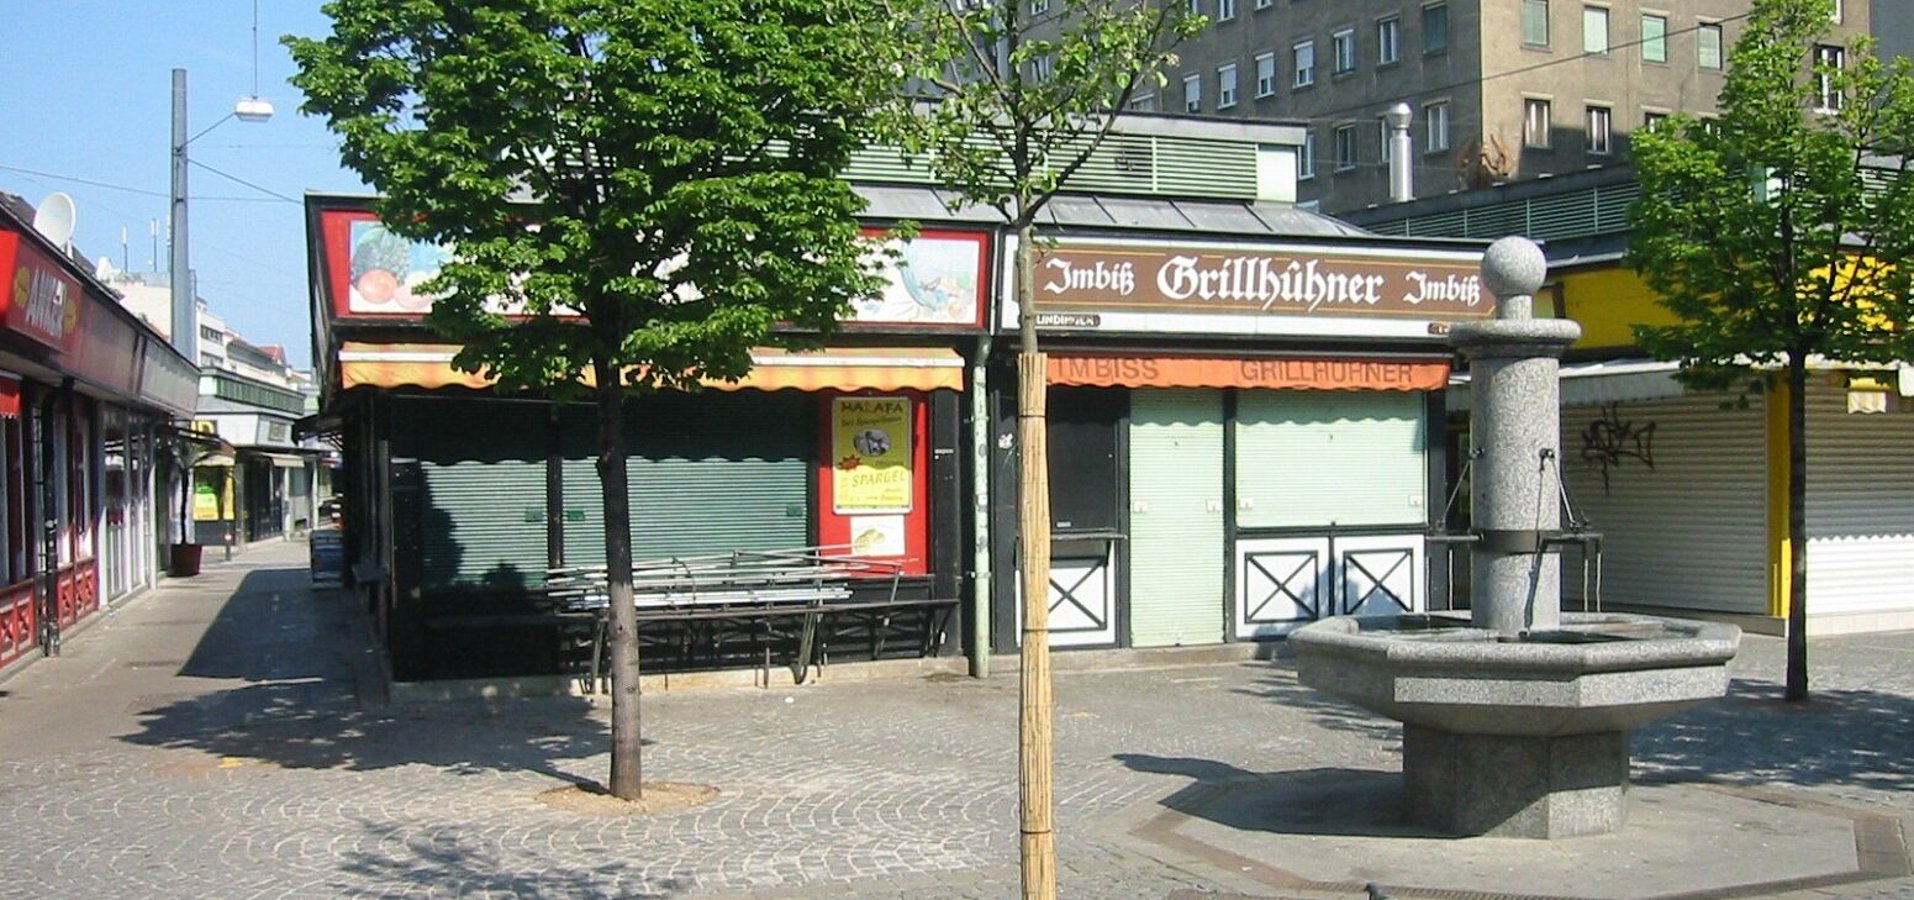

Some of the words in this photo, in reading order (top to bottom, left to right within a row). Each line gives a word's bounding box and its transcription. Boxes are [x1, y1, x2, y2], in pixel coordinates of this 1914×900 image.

[1043, 257, 1135, 296] Imbiß
[1402, 270, 1480, 307] Imbiß
[1057, 358, 1160, 380] IMBISS
[852, 470, 905, 487] SPARGEL
